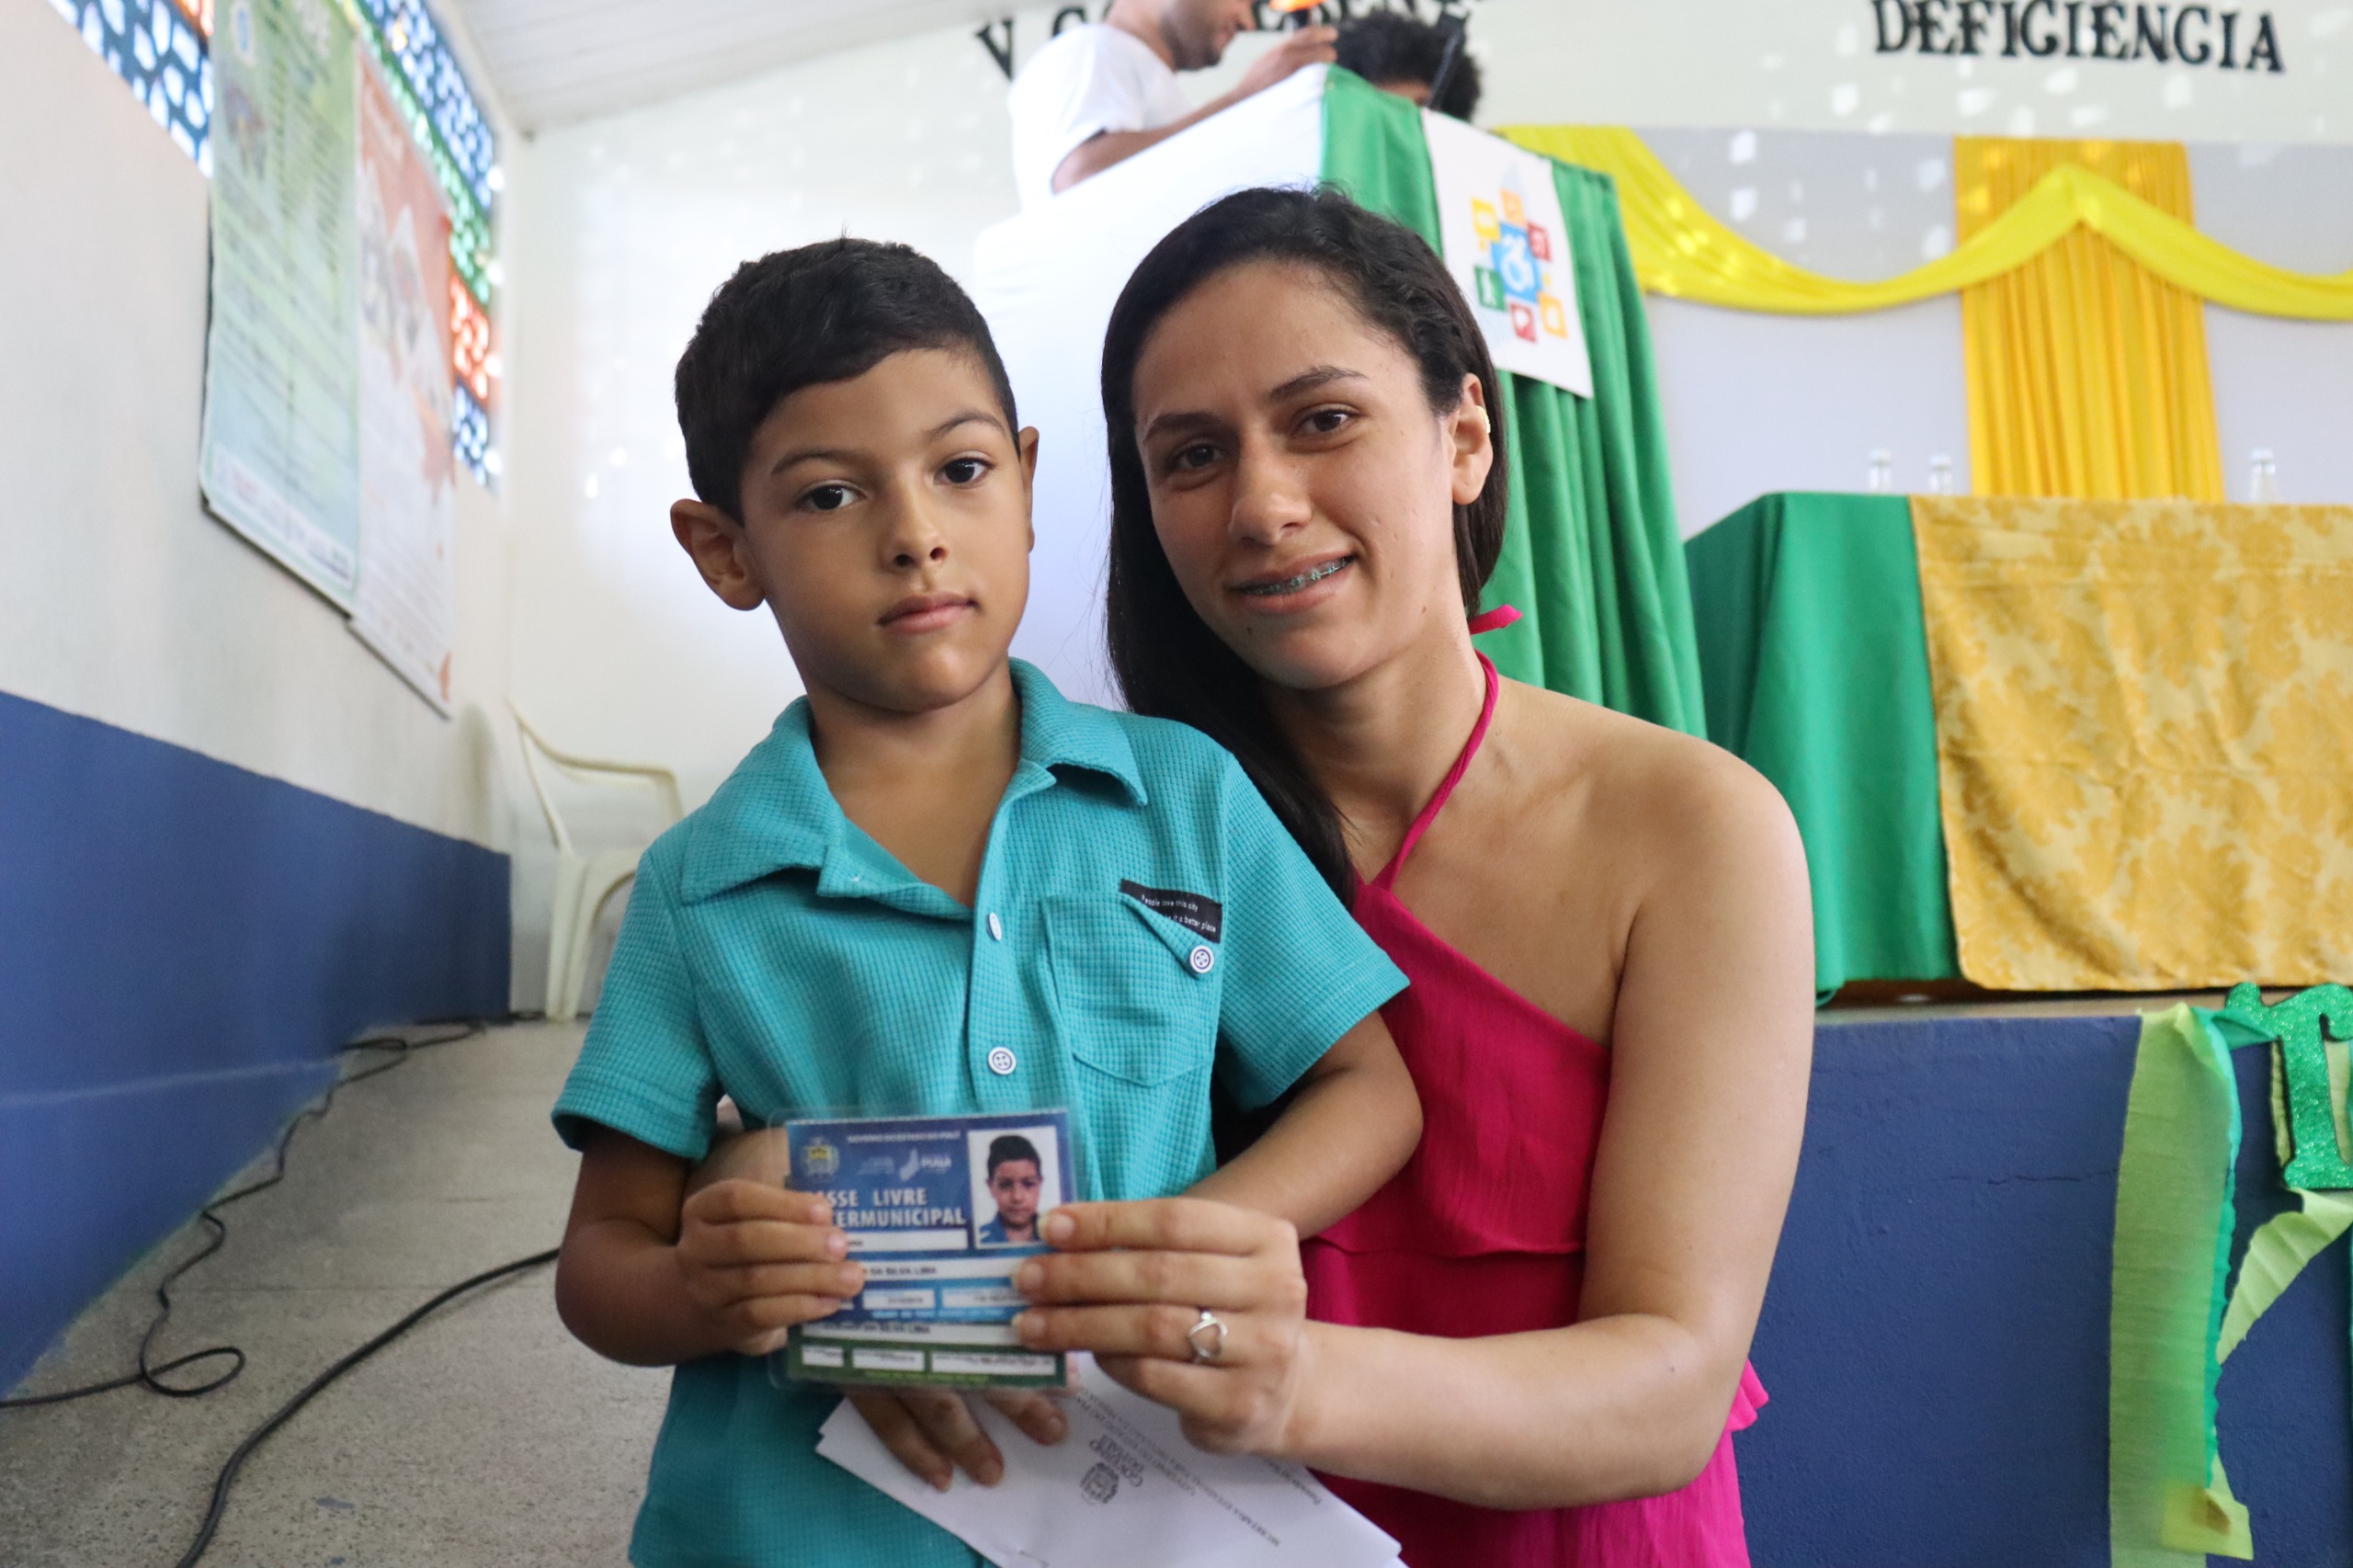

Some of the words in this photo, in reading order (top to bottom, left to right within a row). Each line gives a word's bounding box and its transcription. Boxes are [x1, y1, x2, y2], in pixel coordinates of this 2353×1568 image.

[1142, 894, 1160, 906] People
[1176, 900, 1187, 908] this
[1188, 903, 1199, 912] city
[1184, 915, 1200, 927] better
[1201, 920, 1216, 933] place
[872, 1187, 927, 1206] LIVRE
[835, 1207, 967, 1228] ERMUNICIPAL
